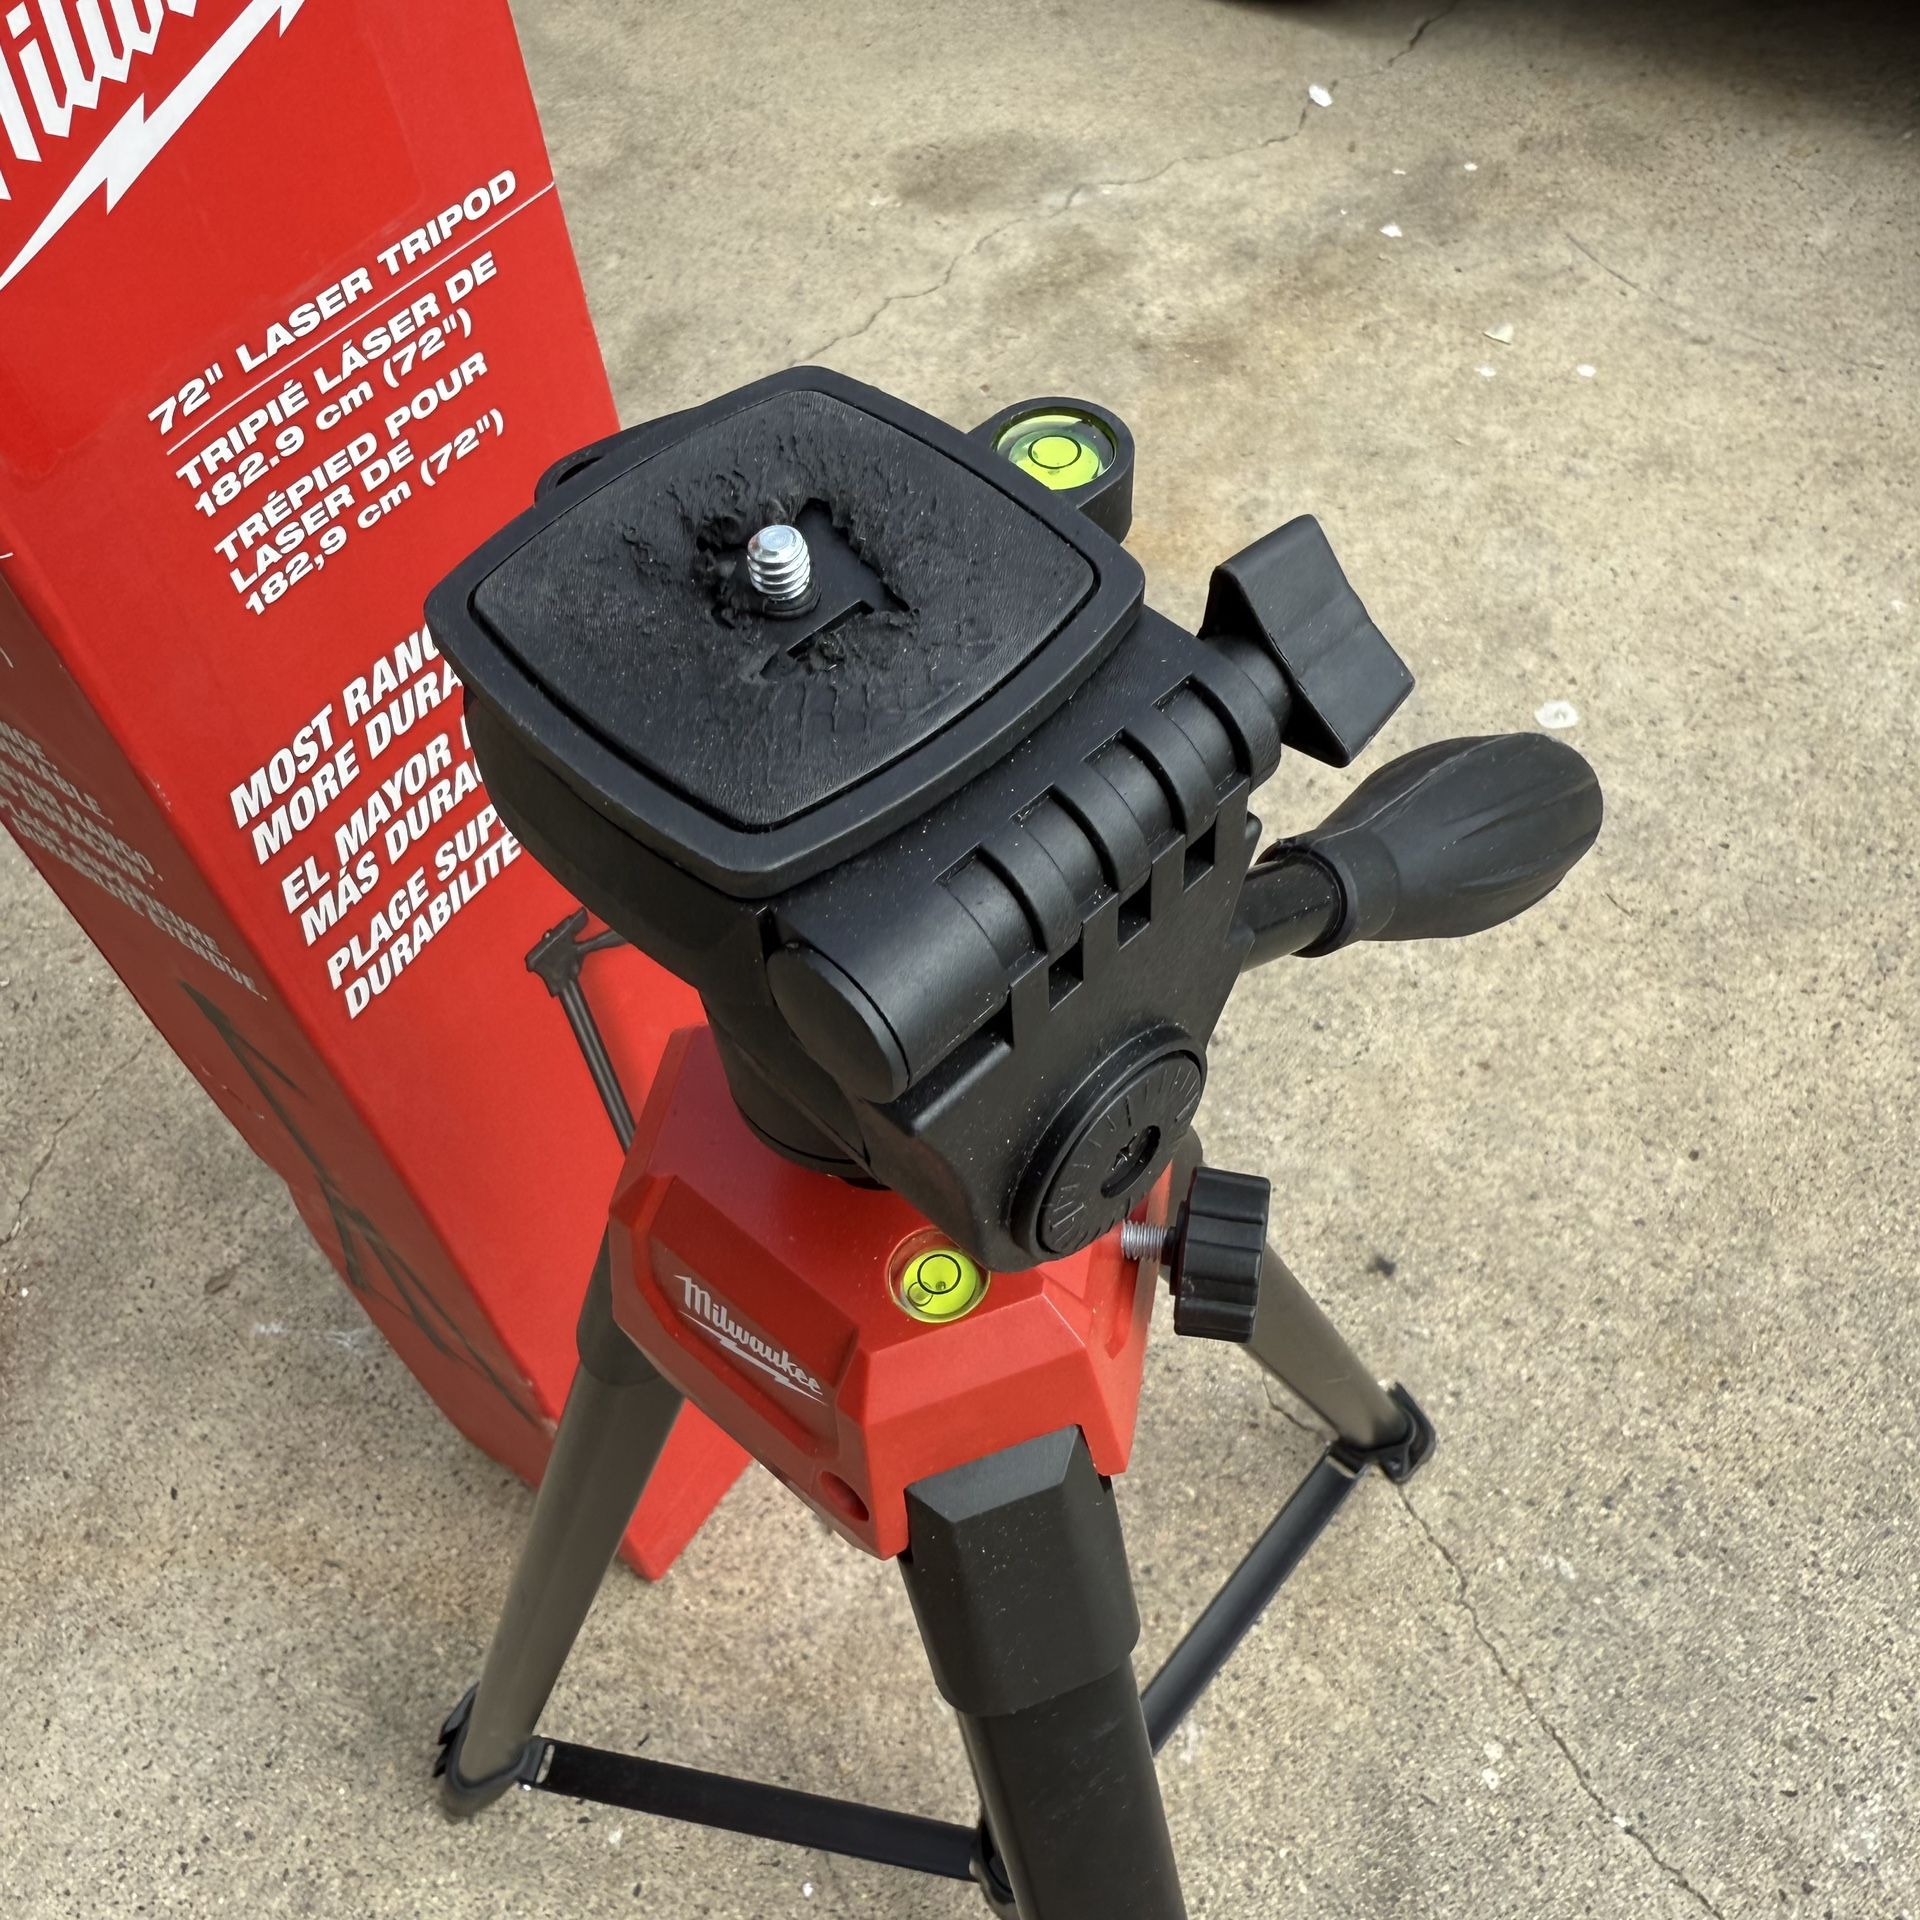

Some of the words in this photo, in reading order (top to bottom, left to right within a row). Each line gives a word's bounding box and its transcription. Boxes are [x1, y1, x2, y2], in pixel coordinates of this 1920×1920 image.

[148, 363, 223, 434] 72"
[236, 268, 373, 372] LASER
[377, 170, 515, 275] TRIPOD
[176, 380, 309, 488] TRIPIÉ
[314, 293, 440, 394] LÁSER
[445, 251, 496, 303] DE
[195, 426, 304, 517] 182.9
[316, 382, 373, 429] cm
[383, 308, 471, 388] (72")
[214, 433, 377, 562] TRÉPIED
[385, 352, 487, 439] POUR
[230, 485, 355, 593] LASER
[360, 439, 414, 491] DE
[246, 526, 346, 615] 182,9
[358, 481, 411, 528] cm
[421, 409, 503, 486] (72")
[230, 704, 333, 828] MOST
[252, 739, 359, 864] MORE
[282, 856, 330, 913] EL
[335, 734, 452, 866] MAYOR
[301, 851, 379, 945] MÁS
[385, 757, 483, 864] DURA
[327, 867, 429, 989] PLAGE
[674, 1274, 824, 1397] Milwaukee
